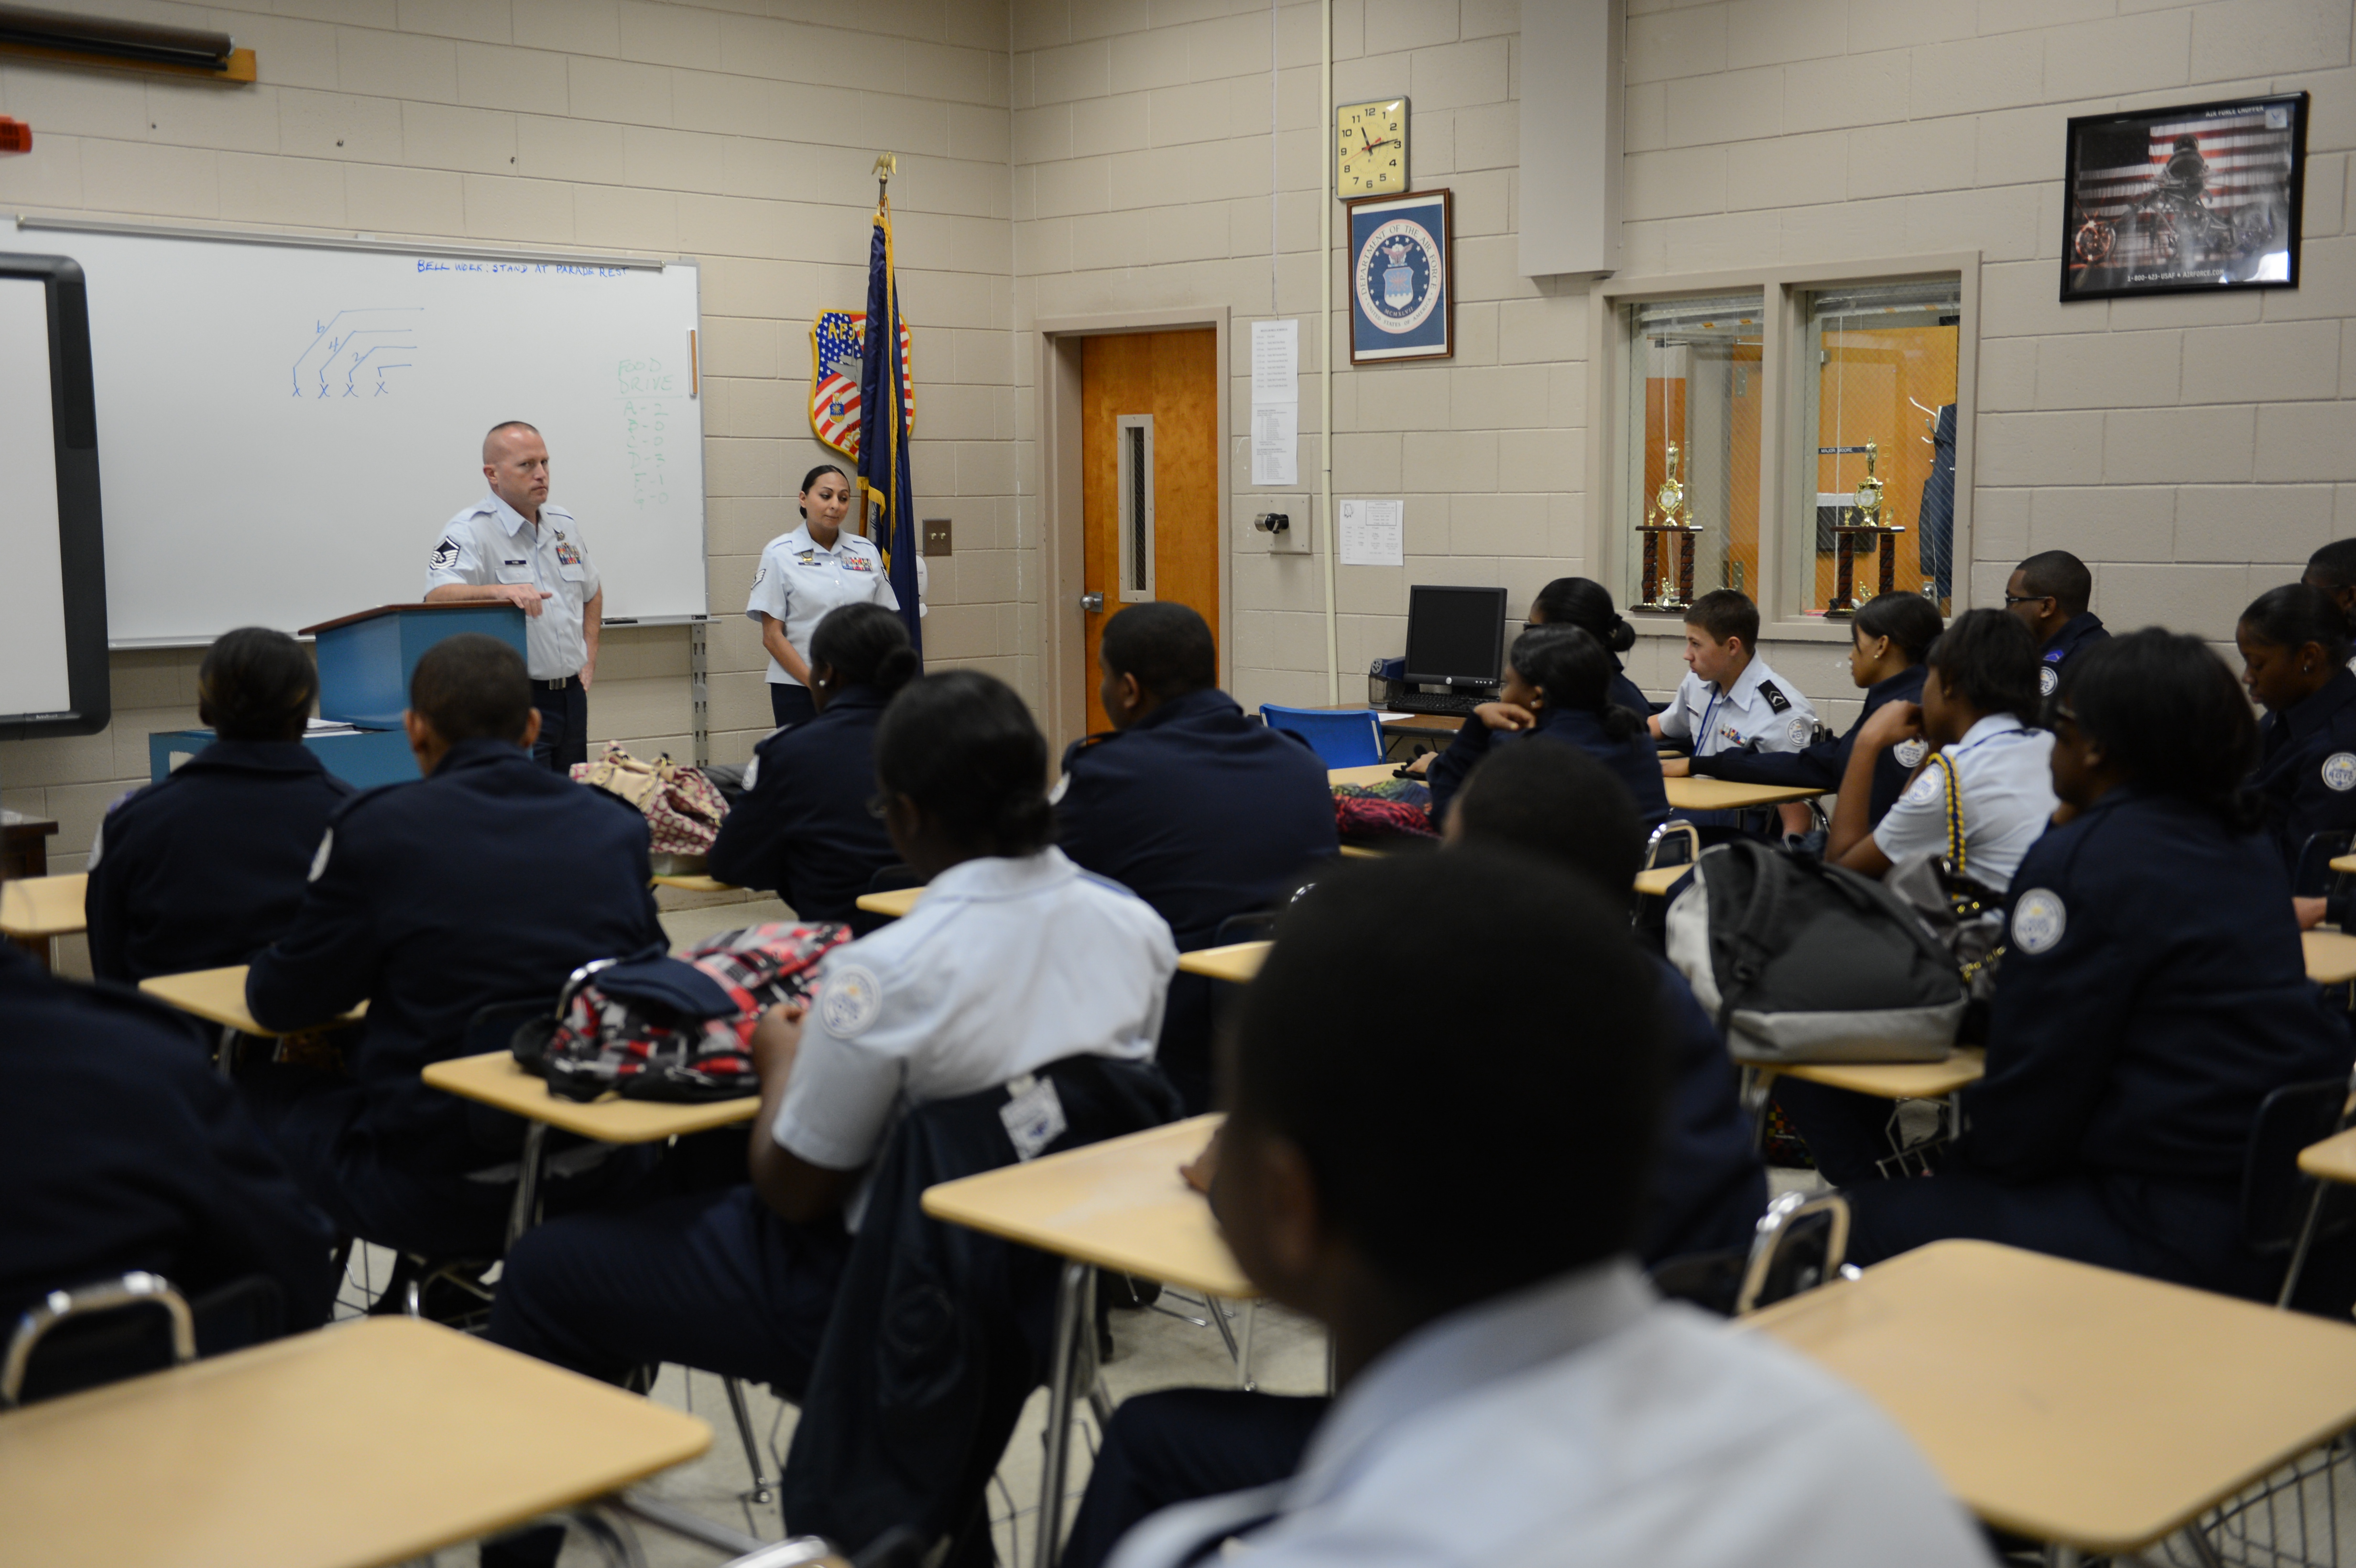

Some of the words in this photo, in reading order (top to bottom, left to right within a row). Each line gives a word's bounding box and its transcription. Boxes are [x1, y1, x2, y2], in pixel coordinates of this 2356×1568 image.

[1364, 108, 1375, 116] 12
[1352, 115, 1361, 123] 11
[1342, 129, 1352, 137] 10
[1390, 123, 1397, 131] 2
[1394, 141, 1401, 149] 3
[1380, 173, 1386, 181] 5
[1366, 180, 1373, 188] 6
[1360, 229, 1386, 295] DEPARTMENT
[1389, 224, 1400, 234] OF
[1405, 225, 1419, 238] THE
[1419, 237, 1432, 252] AIR
[1429, 254, 1438, 290] FORCE
[417, 259, 450, 272] BELL
[492, 264, 528, 273] STAND
[535, 264, 548, 273] AT
[556, 264, 594, 276] PARADE
[599, 266, 629, 278] REST
[2127, 272, 2175, 282] 1-800-423-USAF
[2182, 269, 2224, 278] AIRFORCE.COM
[1367, 302, 1381, 321] UNITED
[1413, 298, 1432, 321] AMERICA
[1384, 306, 1414, 317] MCMXLVII
[328, 337, 339, 352] 4
[351, 352, 365, 362] 2
[618, 358, 662, 376] FOOD
[618, 375, 674, 394] DRIVE
[623, 401, 637, 416] A
[654, 403, 668, 416] 2
[627, 435, 638, 448] C
[628, 452, 641, 469] D
[634, 473, 647, 488] F
[633, 489, 644, 510] G
